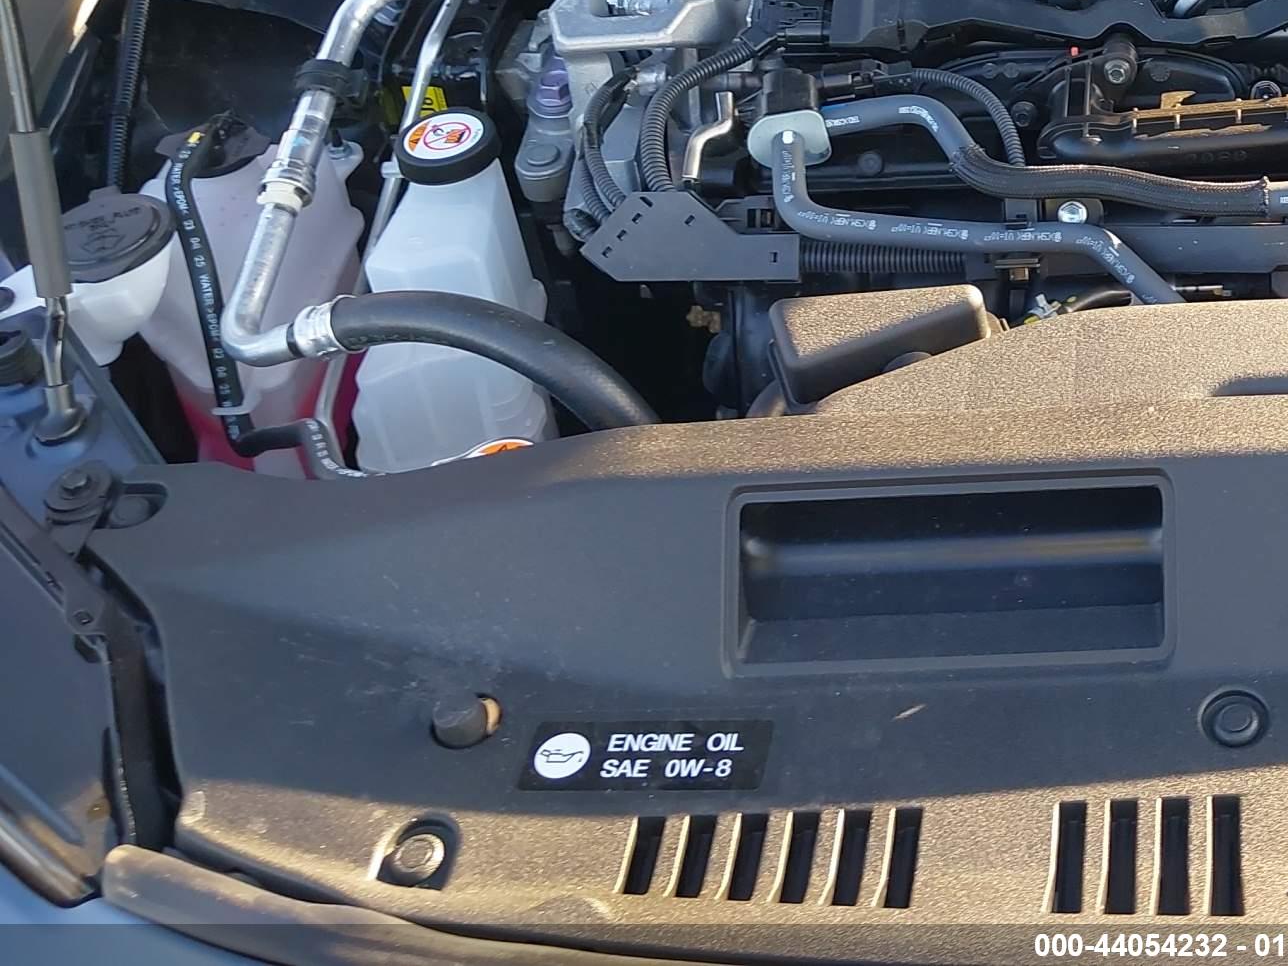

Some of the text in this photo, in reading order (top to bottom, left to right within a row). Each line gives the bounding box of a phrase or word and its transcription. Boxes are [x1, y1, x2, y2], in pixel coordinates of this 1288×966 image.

[199, 274, 215, 306] WATER
[606, 733, 744, 752] ENGINE OIL
[600, 759, 733, 778] SAE 0W-8
